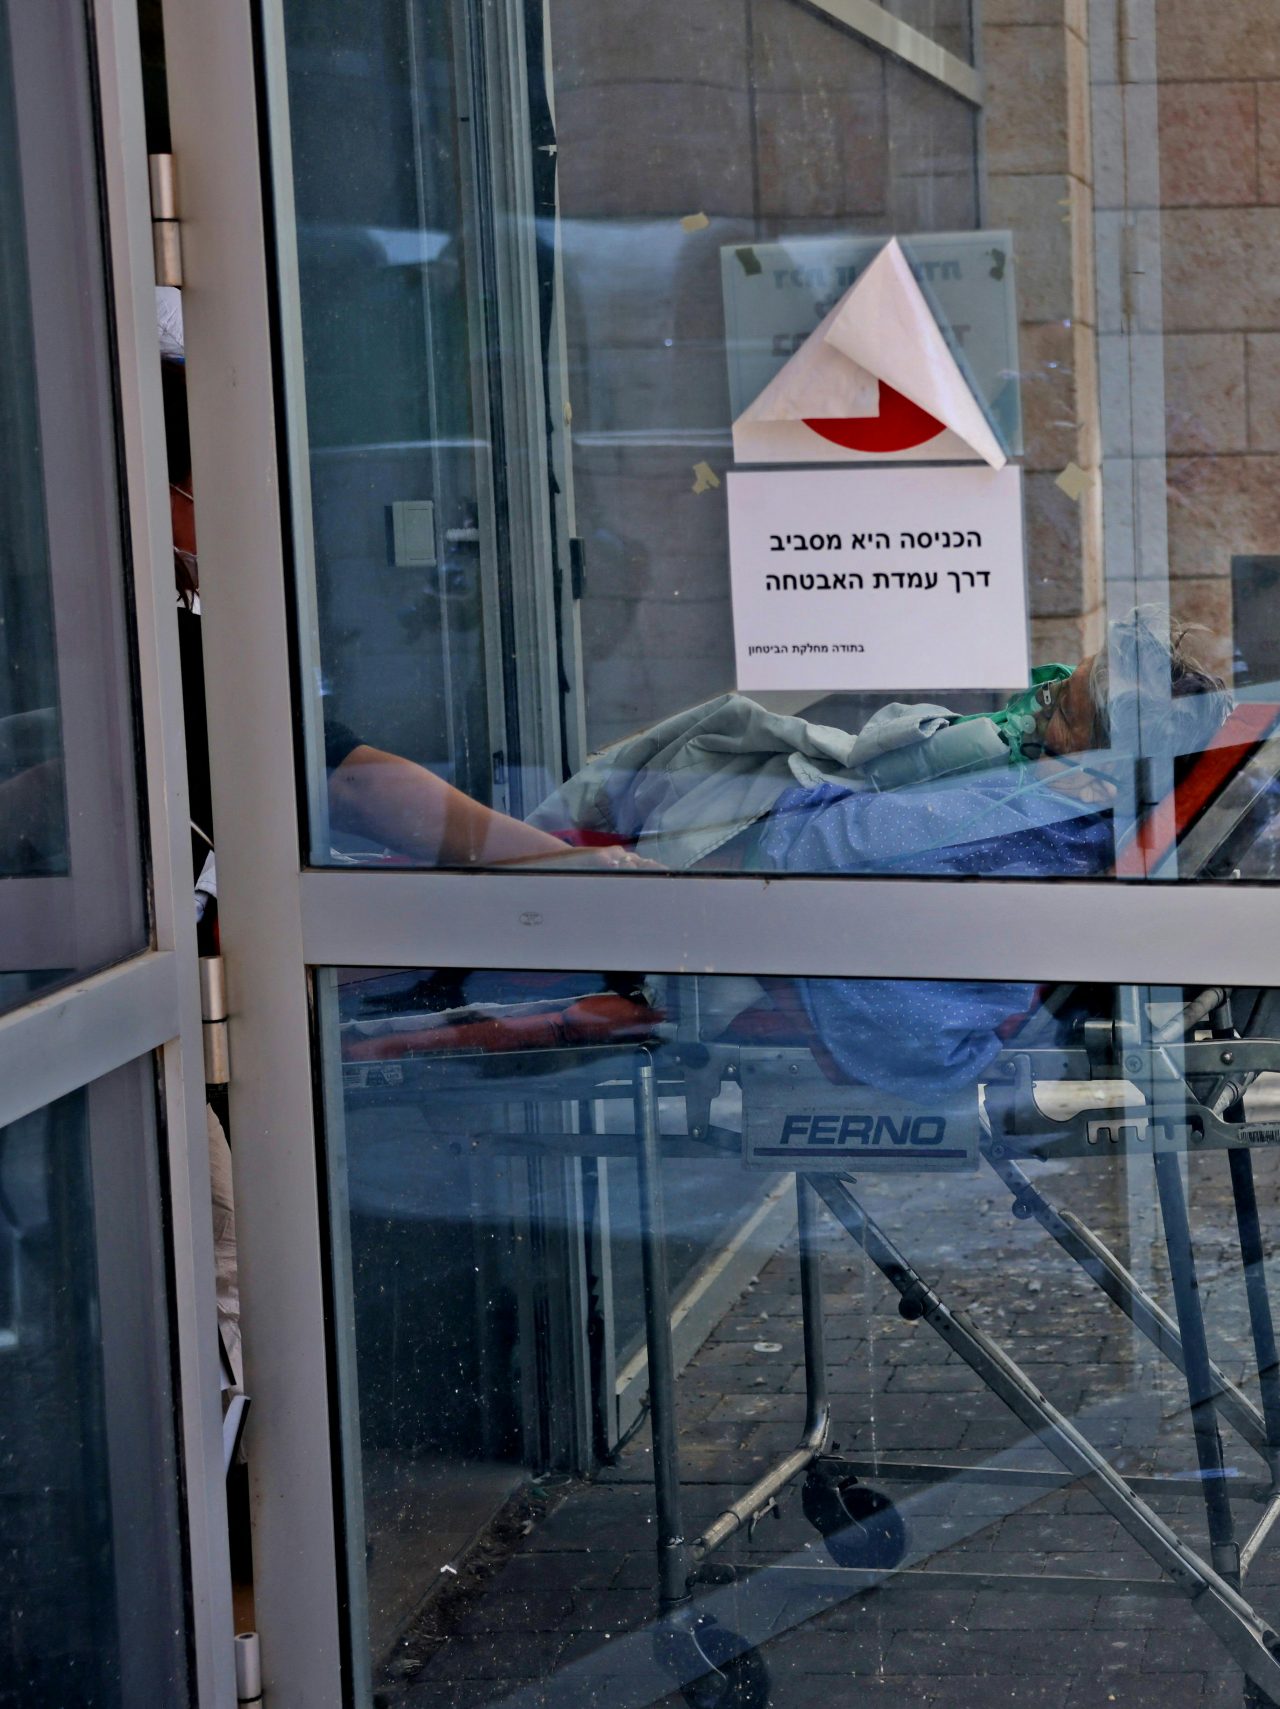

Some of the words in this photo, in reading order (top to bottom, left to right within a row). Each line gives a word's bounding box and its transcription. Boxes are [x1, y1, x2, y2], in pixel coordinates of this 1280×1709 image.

[769, 533, 842, 552] מסביב
[851, 532, 891, 550] היא
[900, 531, 982, 549] הכניסה
[765, 572, 864, 591] האבטחה
[872, 571, 938, 591] עמדת
[946, 570, 991, 594] דרך
[747, 644, 789, 657] הביטחון
[791, 642, 829, 656] מחלקת
[831, 644, 865, 654] בתודה
[779, 1114, 947, 1146] FERNO
